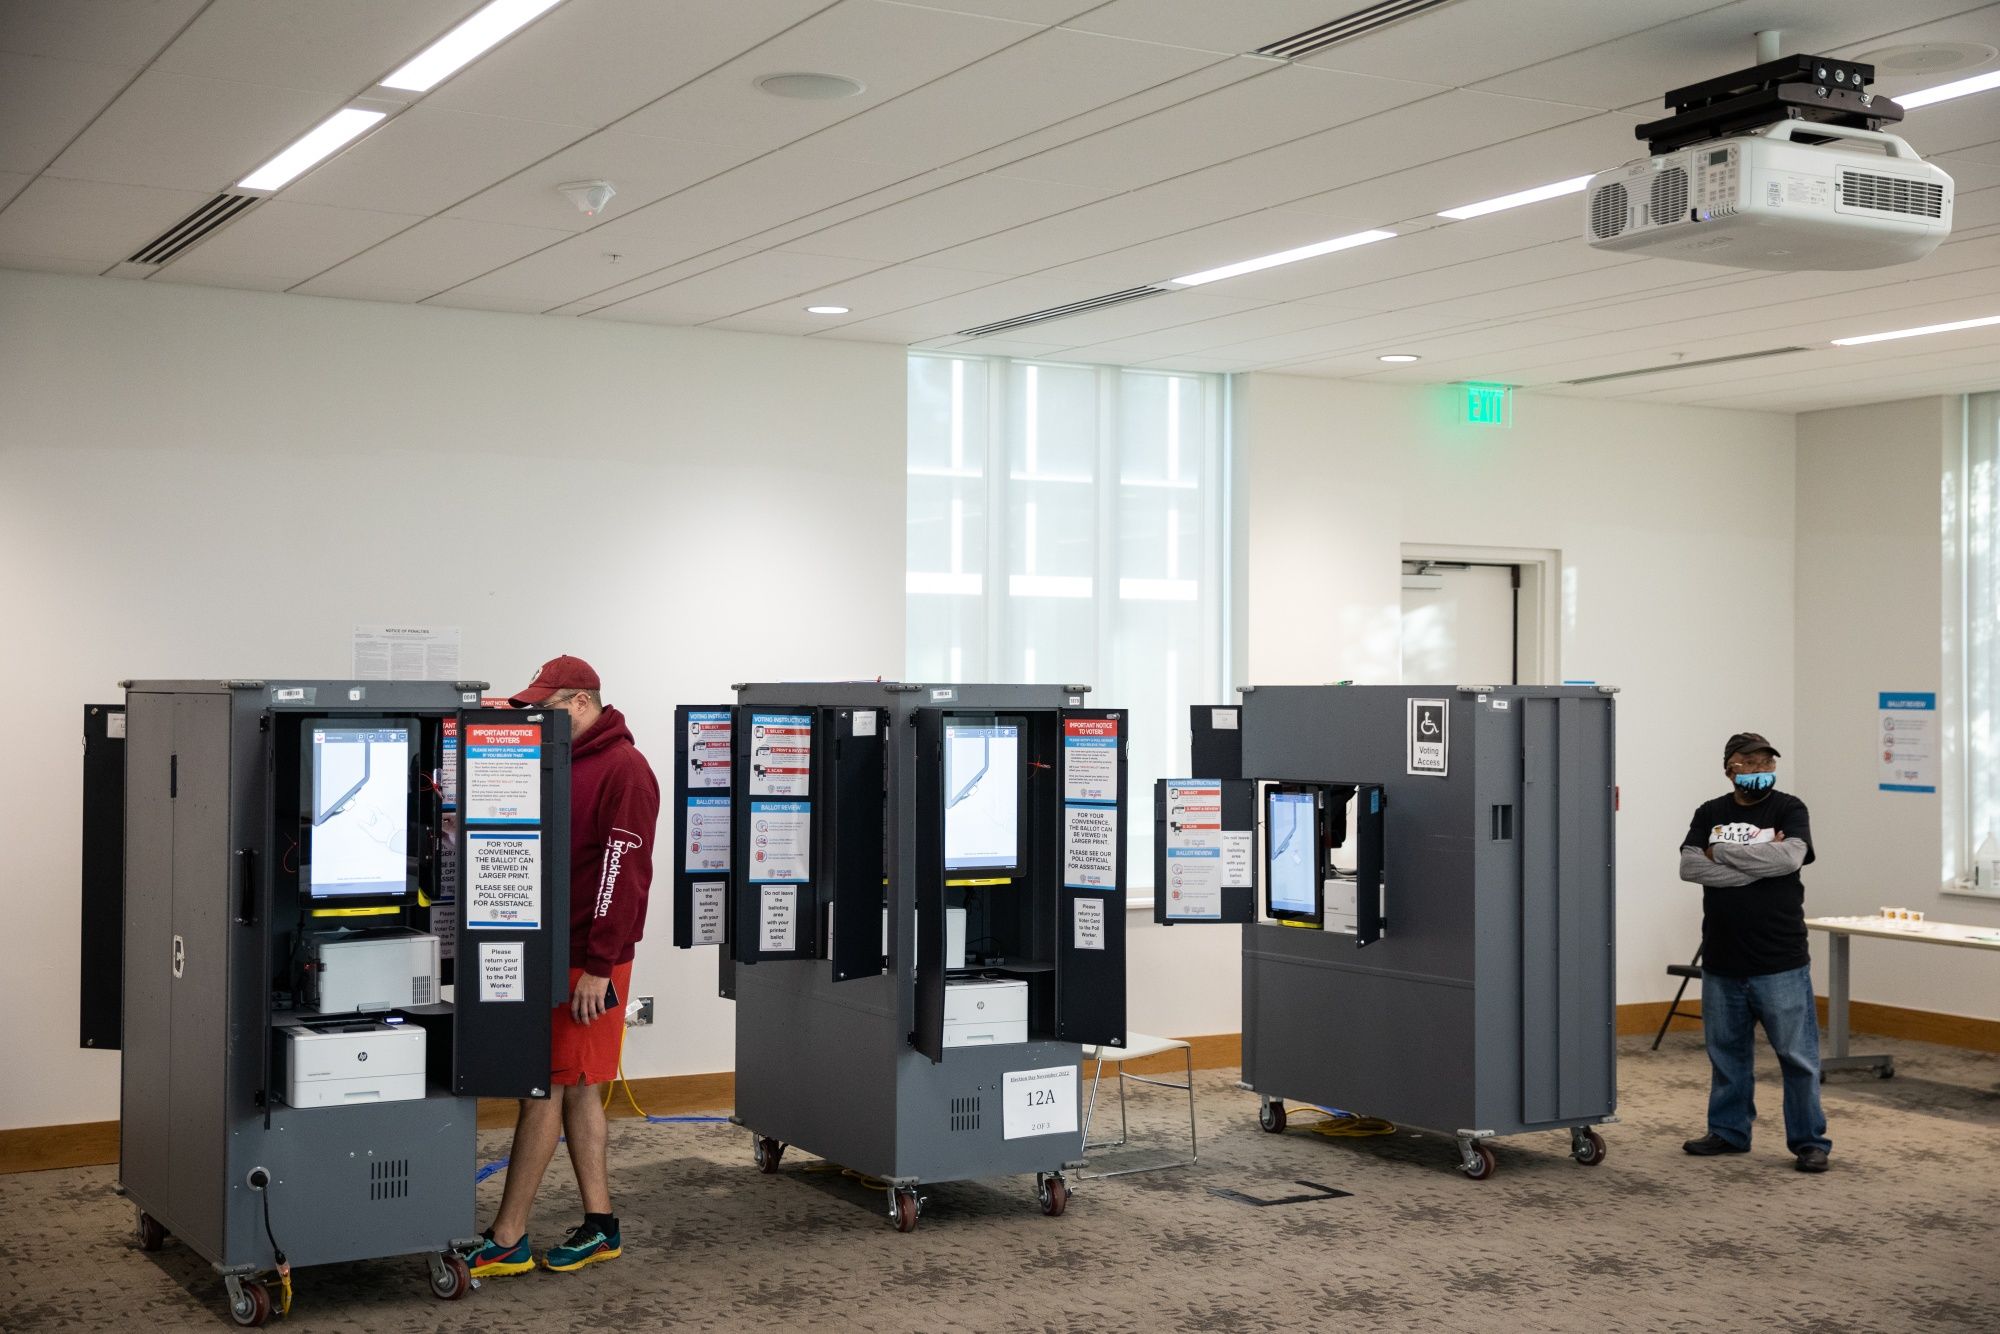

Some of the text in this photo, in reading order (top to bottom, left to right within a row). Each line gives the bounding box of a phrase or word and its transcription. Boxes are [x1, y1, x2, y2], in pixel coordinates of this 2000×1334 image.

[1469, 389, 1503, 424] EXIT
[1419, 746, 1439, 756] Voting
[1418, 758, 1440, 766] Access
[599, 840, 625, 917] brockhampton
[1027, 1089, 1055, 1106] 12A
